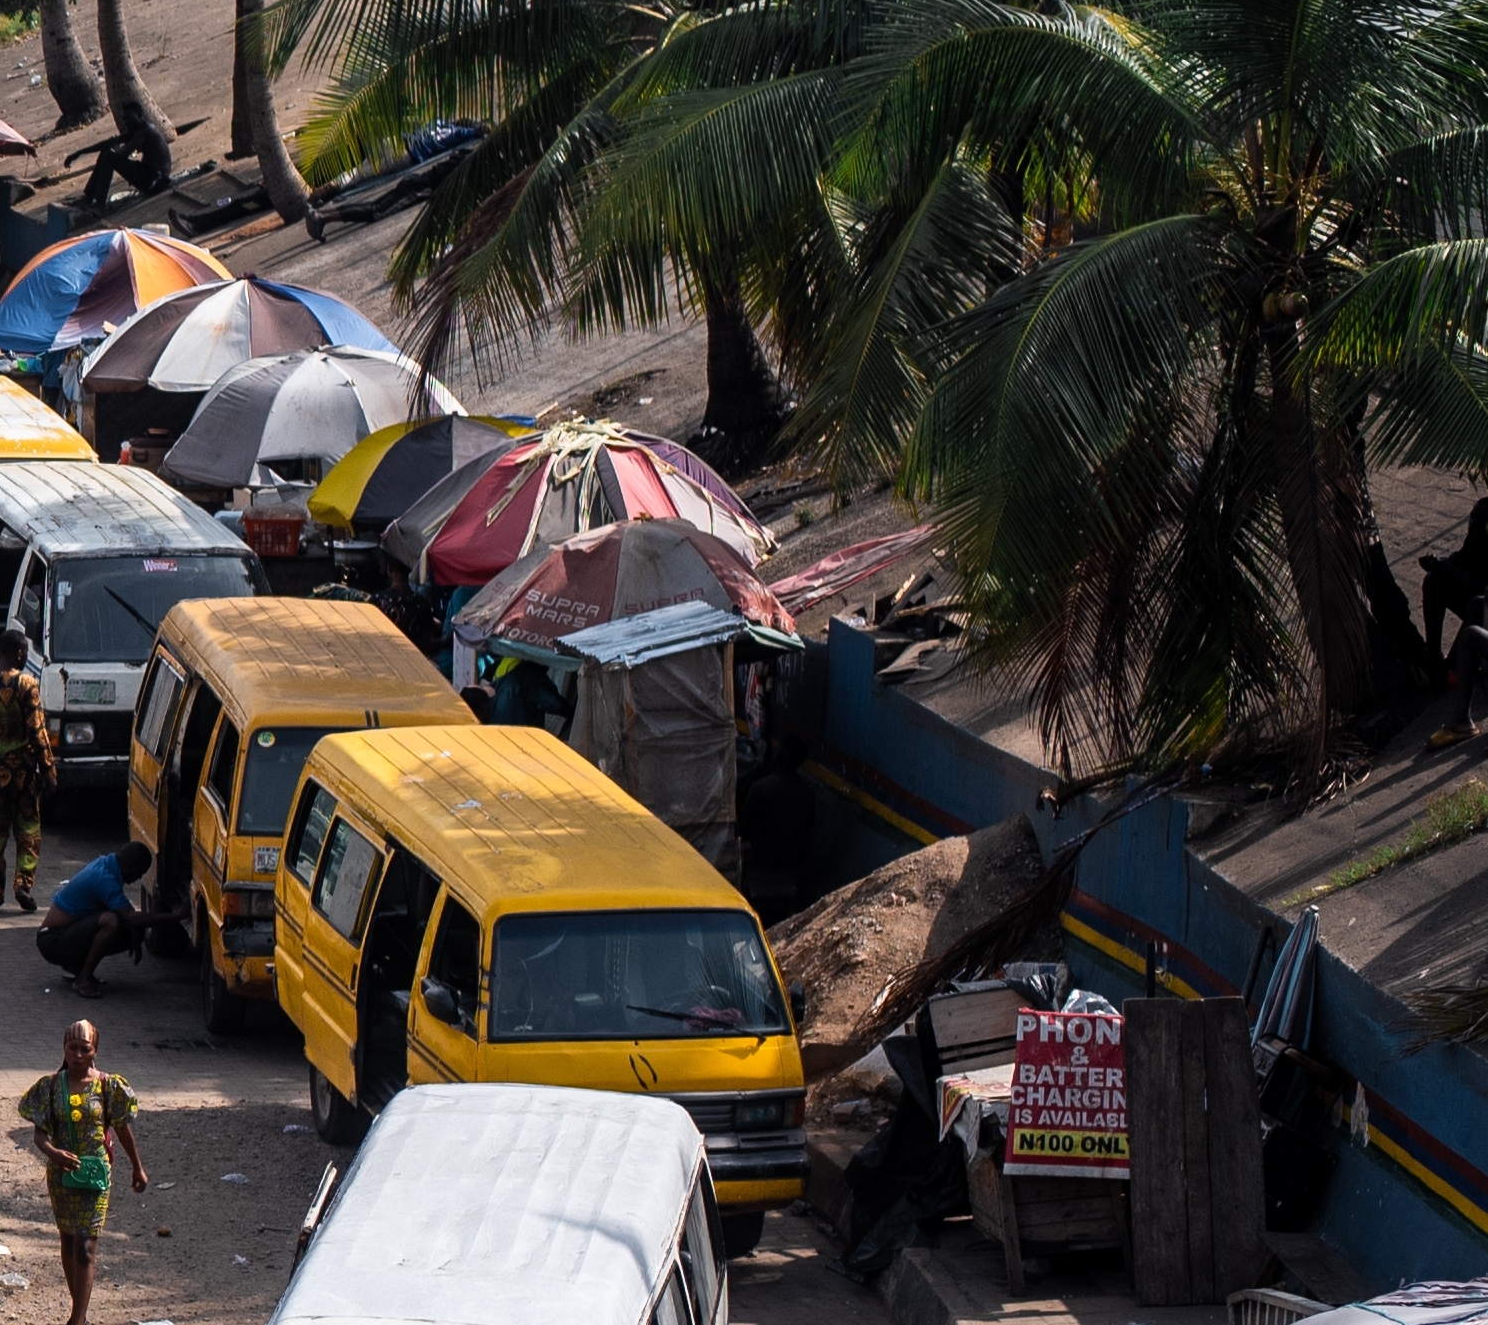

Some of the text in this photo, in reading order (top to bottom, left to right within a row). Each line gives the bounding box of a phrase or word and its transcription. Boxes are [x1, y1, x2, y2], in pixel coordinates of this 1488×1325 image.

[524, 588, 601, 617] SUPRA
[524, 602, 588, 628] MARS
[1016, 1015, 1122, 1045] PHON
[1070, 1046, 1090, 1066] &
[1018, 1065, 1124, 1089] BATTER
[1010, 1086, 1128, 1109] CHARGIN
[1014, 1109, 1128, 1129] IS AVAILABL
[1017, 1131, 1075, 1154] N100
